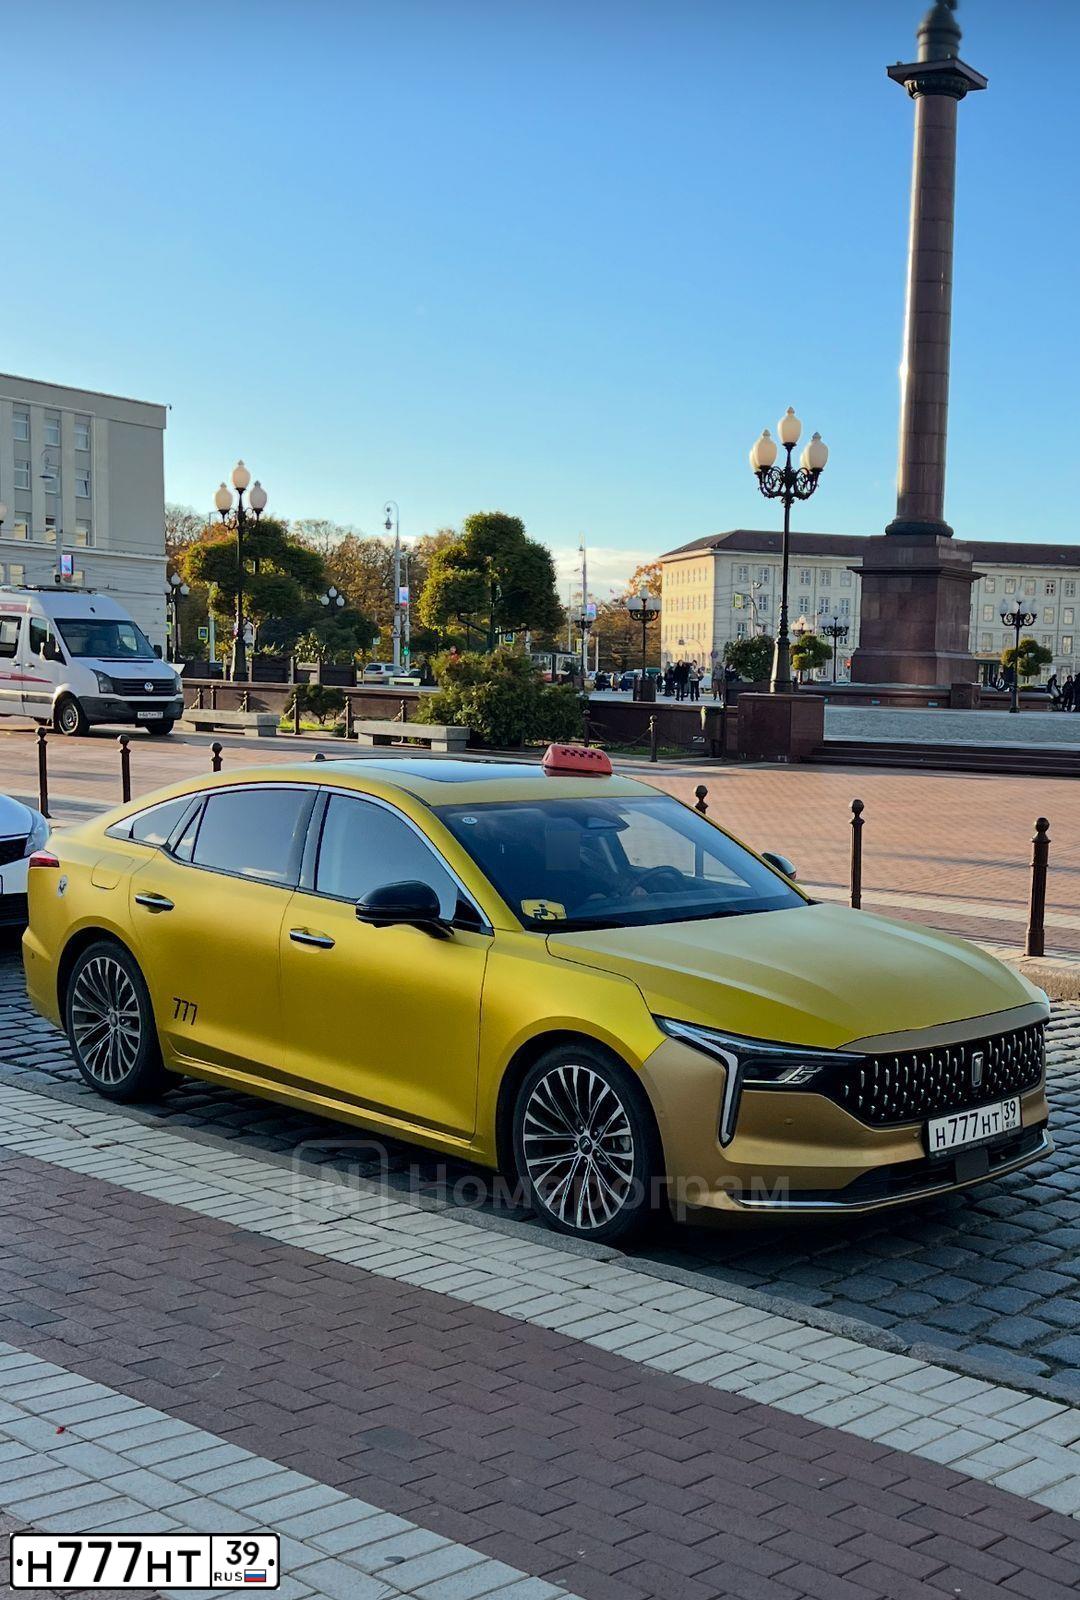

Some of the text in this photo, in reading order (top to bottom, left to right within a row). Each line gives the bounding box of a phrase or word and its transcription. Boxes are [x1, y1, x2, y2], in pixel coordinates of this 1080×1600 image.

[173, 997, 198, 1025] 777
[935, 1112, 1000, 1148] Н777НТ
[1003, 1100, 1017, 1121] 39
